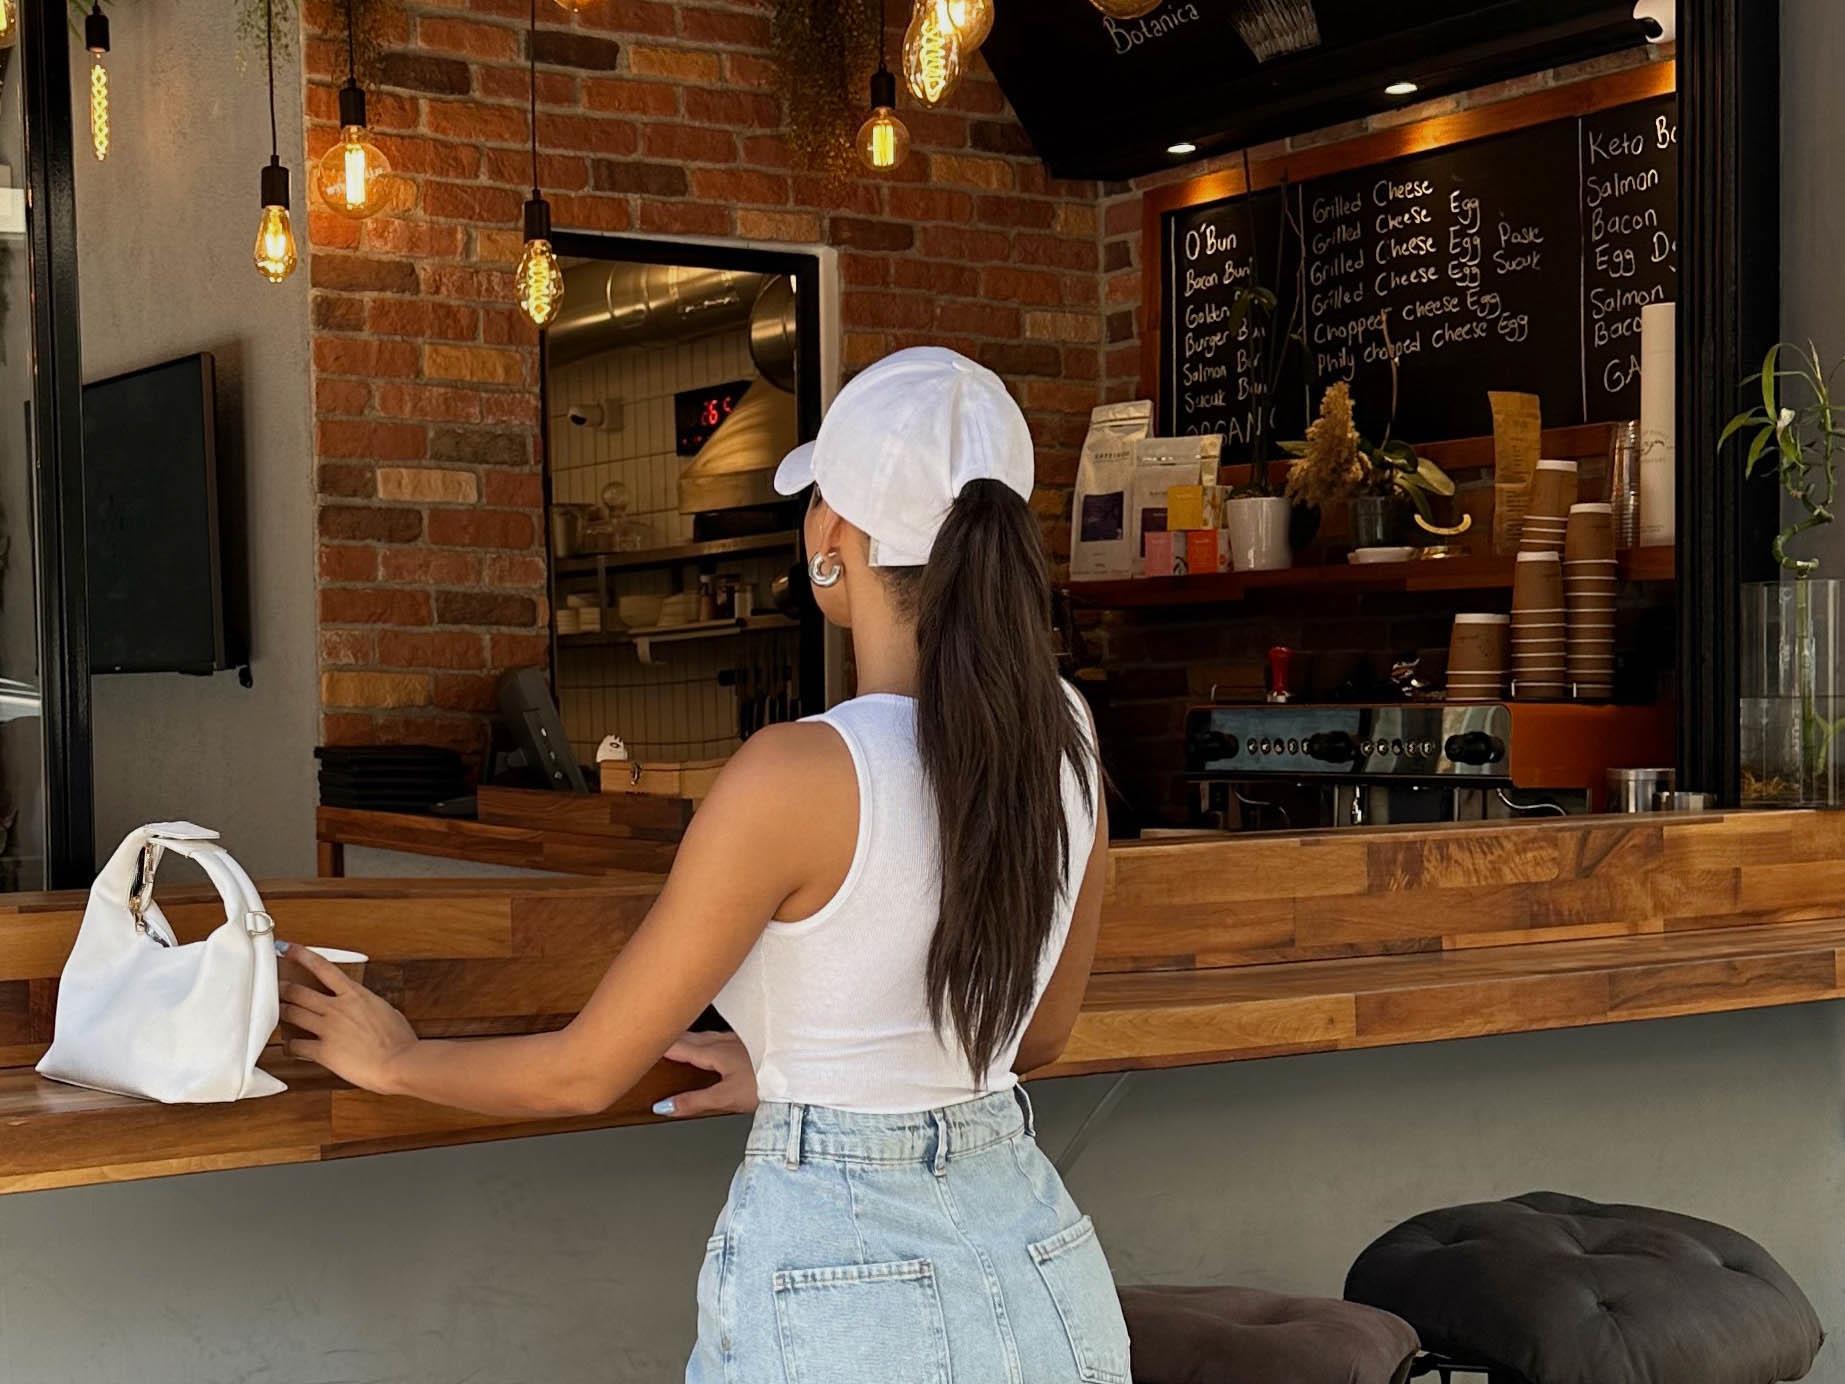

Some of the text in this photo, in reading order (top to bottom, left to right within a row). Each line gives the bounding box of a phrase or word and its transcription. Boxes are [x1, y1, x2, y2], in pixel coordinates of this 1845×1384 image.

[1103, 3, 1200, 55] Botanica
[1589, 130, 1643, 165] Keto
[1312, 180, 1433, 223] Grilled Cheese
[1587, 169, 1658, 207] Salmon
[1312, 190, 1480, 254] Grilled Cheese Egg
[1592, 208, 1657, 242] Bacon
[1311, 248, 1364, 285] Grilled
[1376, 236, 1437, 264] Cheese
[1449, 225, 1481, 265] Egg
[1595, 243, 1635, 277] Egg
[1184, 269, 1218, 297] Bacon
[1311, 281, 1363, 316] Grilled
[1375, 266, 1438, 296] Cheese
[1448, 261, 1480, 286] Egg
[1185, 303, 1230, 328] Golden
[1466, 287, 1501, 319] Egg
[1590, 285, 1664, 319] Salmon
[1498, 312, 1528, 341] Egg
[1185, 332, 1229, 358] Burger
[1183, 363, 1227, 386] Salmon
